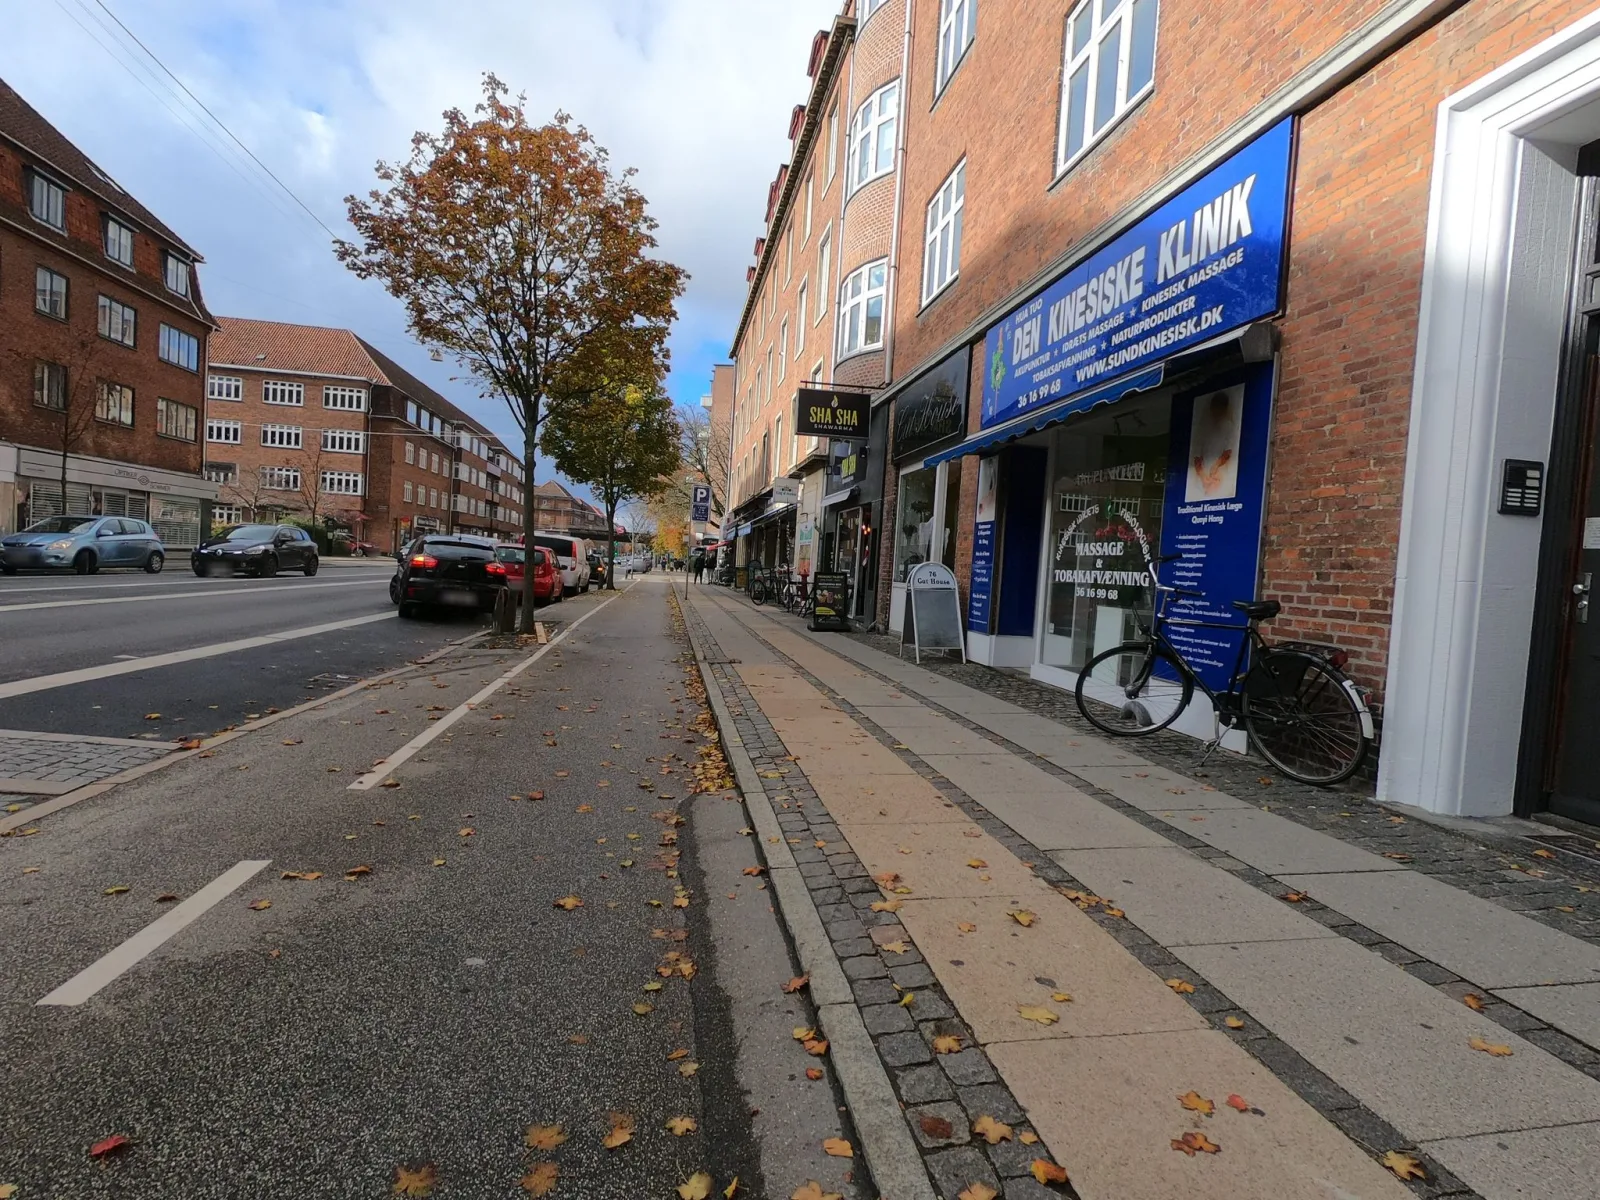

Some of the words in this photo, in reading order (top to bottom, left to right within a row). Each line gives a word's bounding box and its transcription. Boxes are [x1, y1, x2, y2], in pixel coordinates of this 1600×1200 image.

[1012, 313, 1042, 366] DEN
[1047, 246, 1146, 346] KINESISKE
[1157, 173, 1256, 285] KLINIK
[1014, 351, 1051, 379] AKUPUNKTUR
[1062, 332, 1087, 354] IDRÆTS
[1088, 311, 1125, 341] MASSAGE
[1141, 278, 1187, 313] KINESISK
[1187, 247, 1245, 290] MASSAGE
[1015, 308, 1029, 325] HUA
[1029, 298, 1043, 316] TUO
[1032, 344, 1097, 384] TOBAKSAFVÆNNING
[1111, 295, 1196, 346] NATURPRODUKTER
[1075, 304, 1224, 383] WWW.SUNDKINESISK.DK
[1017, 393, 1028, 409] 36
[1028, 390, 1038, 404] 16
[1038, 384, 1049, 399] 99
[1050, 378, 1061, 394] 68
[809, 406, 832, 424] SHA
[836, 408, 858, 426] SHA
[814, 423, 853, 432] SHAWARMA
[697, 488, 707, 501] P
[1075, 541, 1124, 556] MASSAGE
[1095, 560, 1103, 568] &
[1054, 569, 1150, 587] TOBAKAFVÆNNING
[1076, 586, 1085, 597] 36
[1086, 587, 1095, 598] 16
[1096, 588, 1106, 599] 99
[1107, 589, 1118, 600] 68
